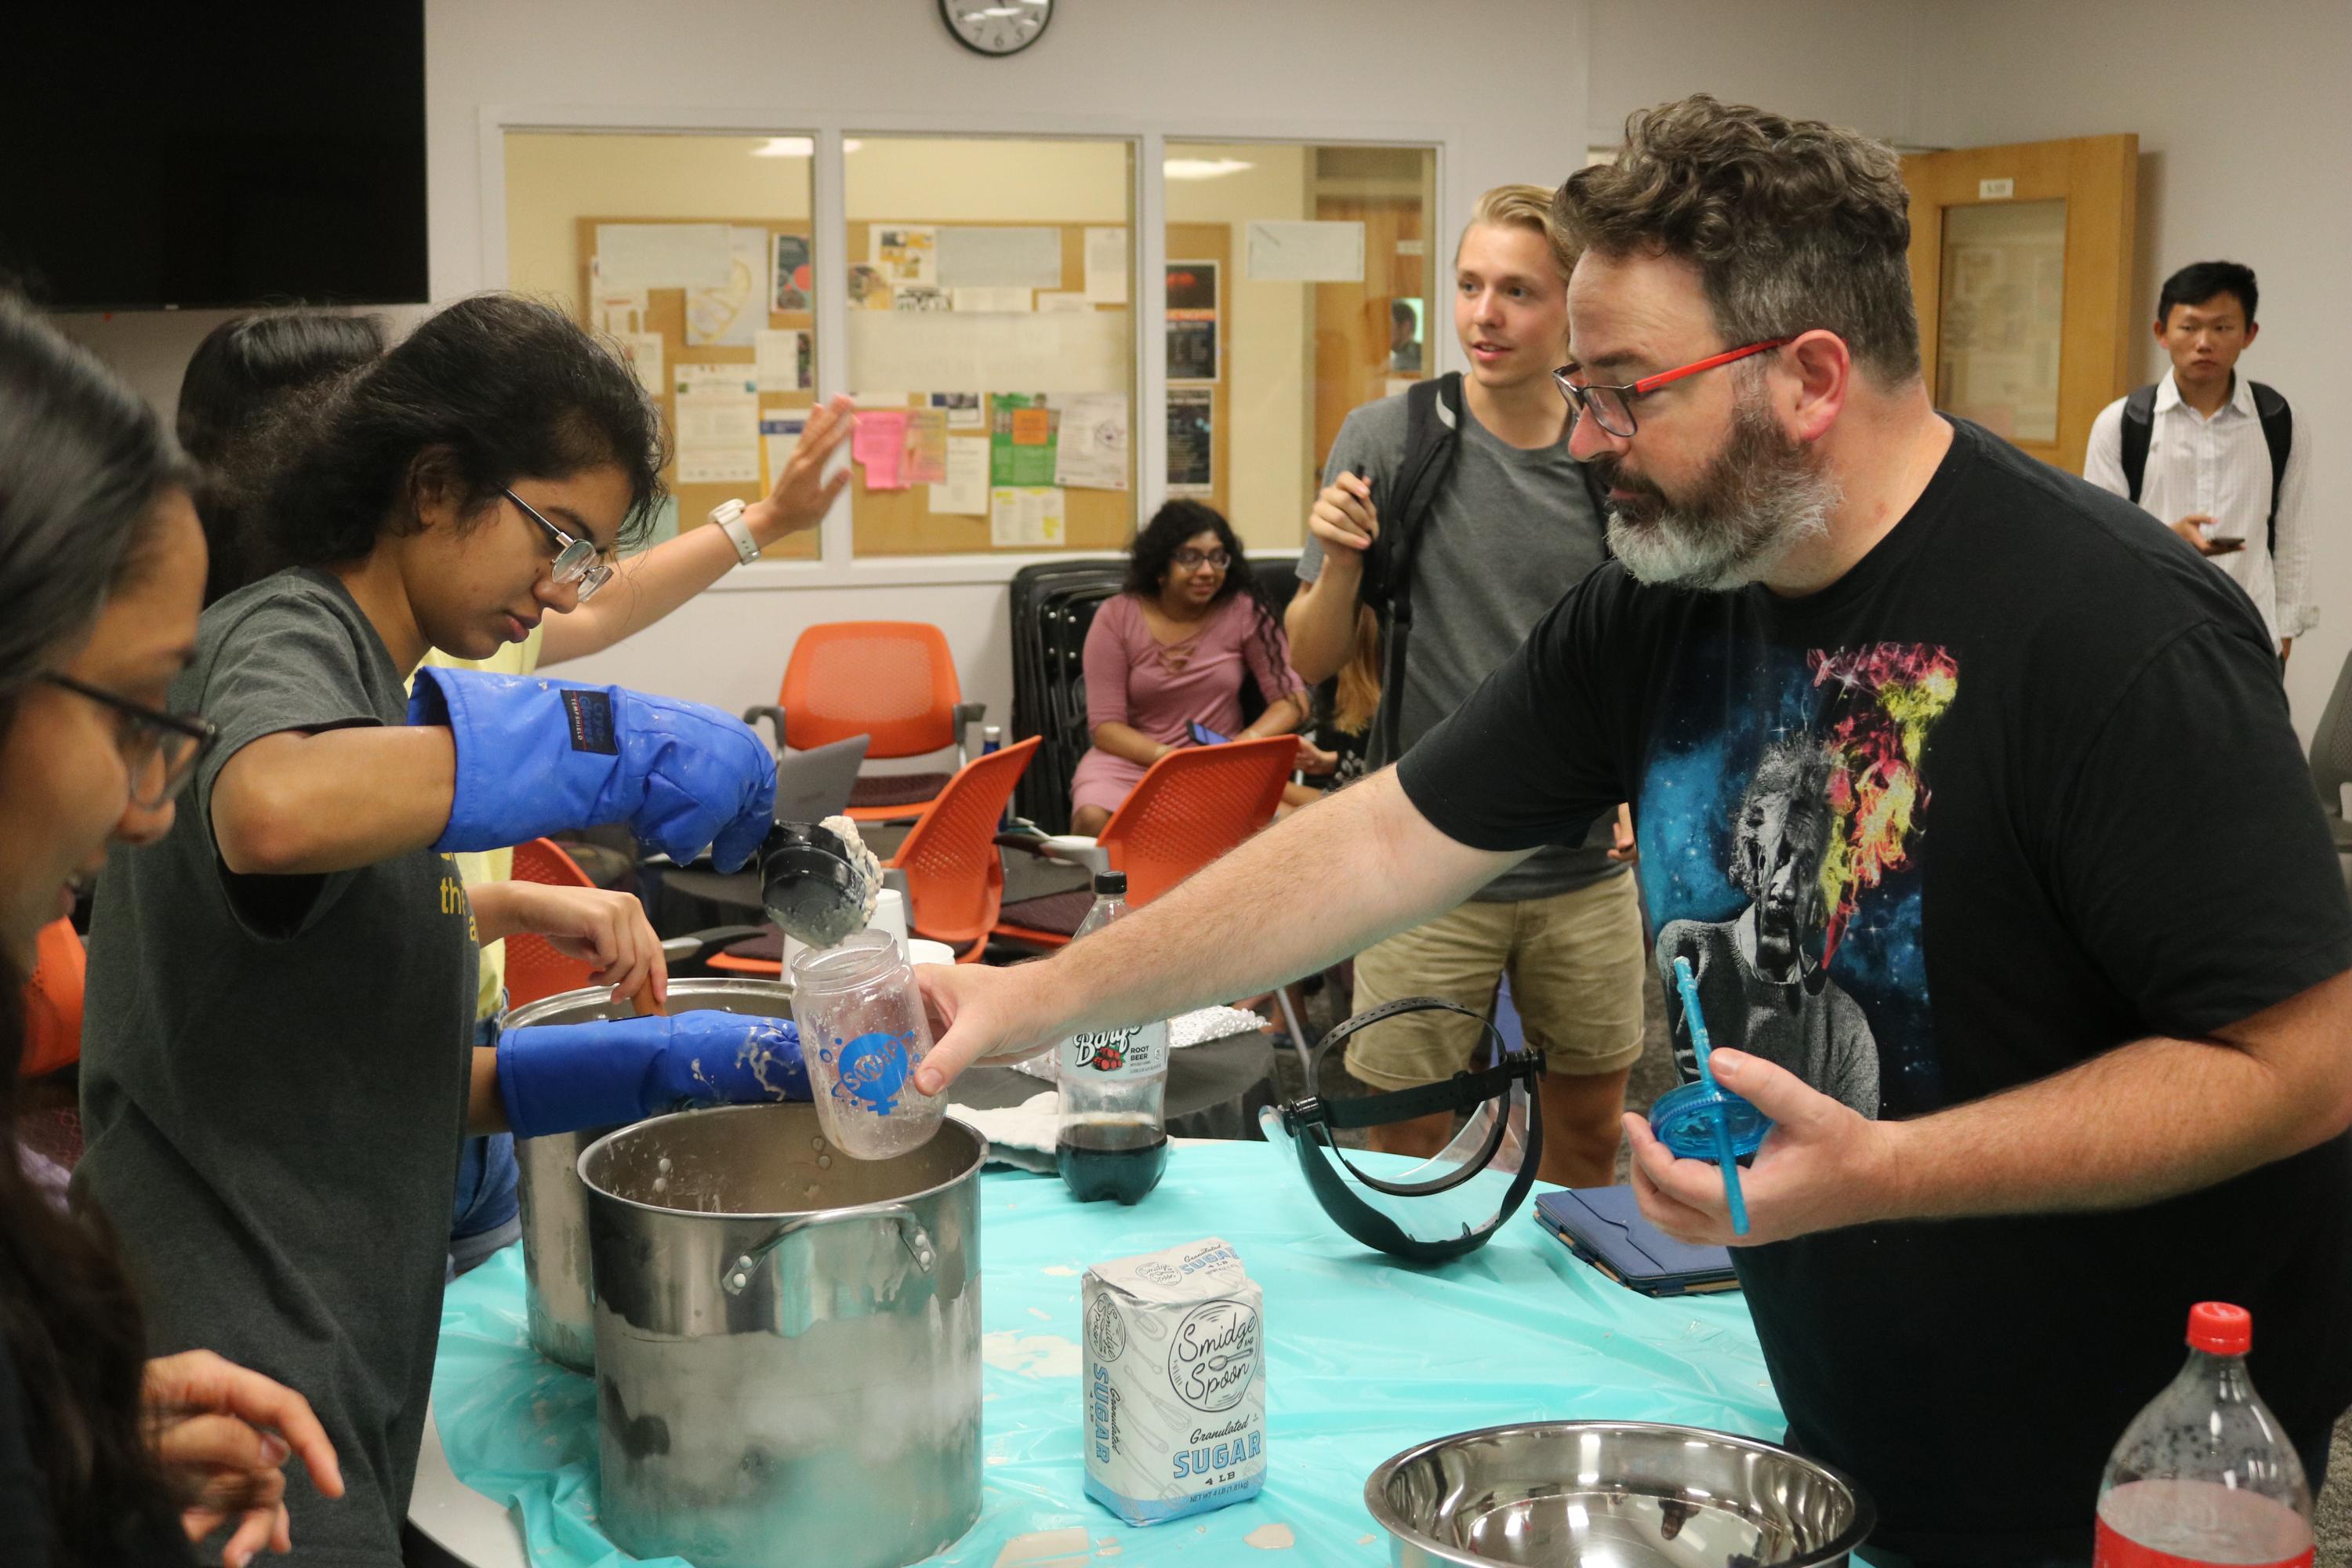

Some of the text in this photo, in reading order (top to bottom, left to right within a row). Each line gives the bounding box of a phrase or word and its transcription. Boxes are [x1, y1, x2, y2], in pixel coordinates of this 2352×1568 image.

[993, 32, 1004, 47] 6
[571, 698, 583, 741] TEMPSHIELD
[1184, 1243, 1221, 1263] Granulated
[1093, 1299, 1106, 1348] Spoon
[1103, 1302, 1119, 1360] Smidge
[1178, 1312, 1256, 1362] Smidge
[1244, 1336, 1254, 1347] AND
[1185, 1363, 1250, 1406] Spoon
[1094, 1363, 1109, 1464] SUGAR
[1110, 1387, 1120, 1456] Granulated
[1190, 1414, 1250, 1444] Granulated
[1173, 1430, 1261, 1479] SUGAR
[1190, 1494, 1203, 1503] NET
[1218, 1487, 1226, 1496] LB
[1205, 1471, 1235, 1486] 4 LB
